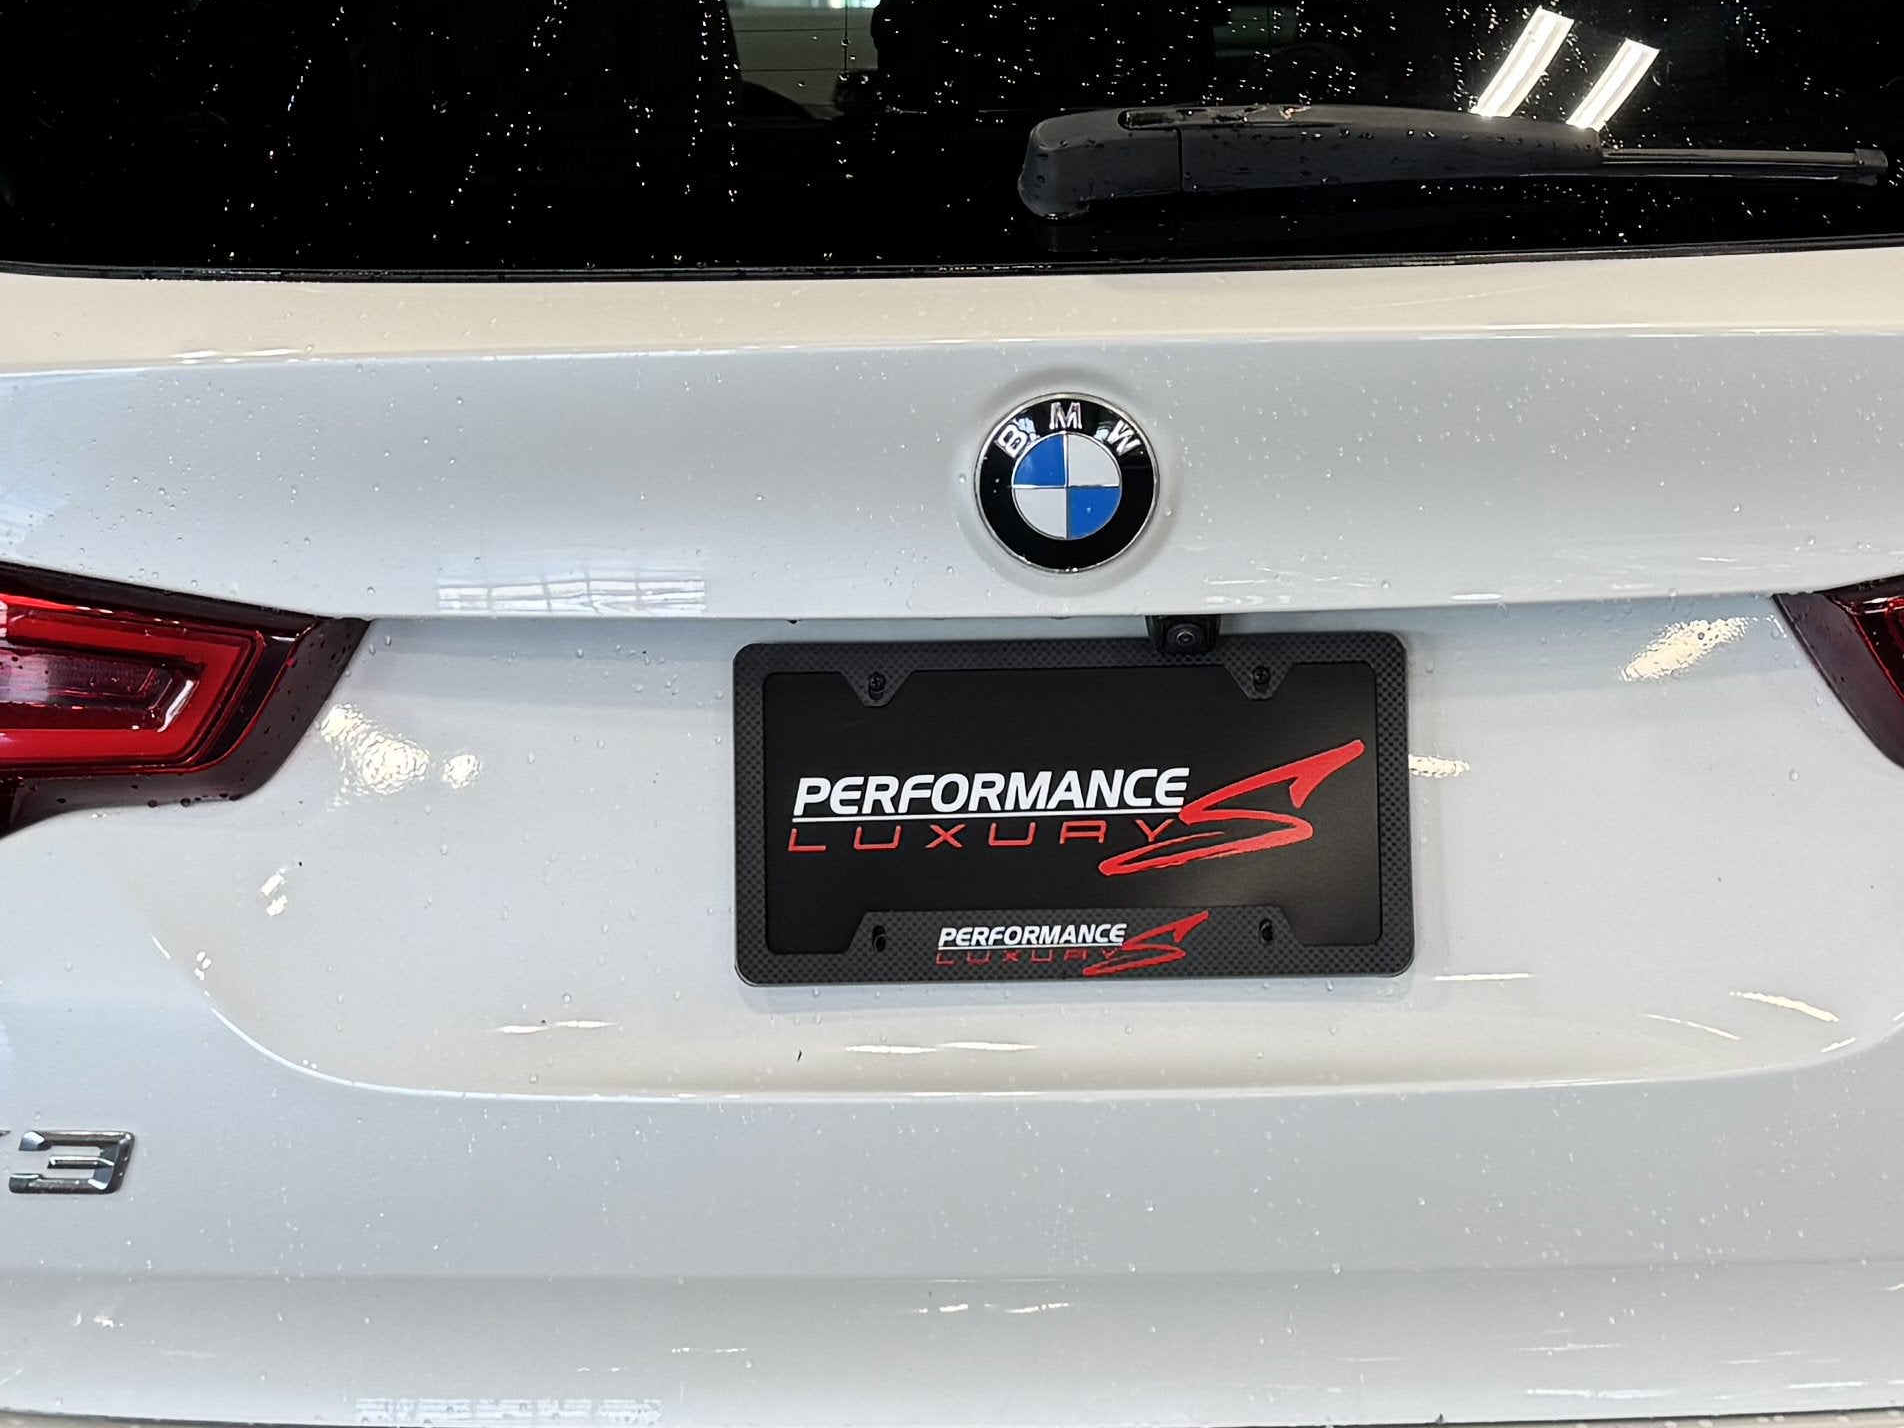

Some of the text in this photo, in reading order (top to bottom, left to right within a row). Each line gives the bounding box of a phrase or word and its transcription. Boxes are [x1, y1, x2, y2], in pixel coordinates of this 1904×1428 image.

[995, 401, 1142, 458] BMW
[793, 767, 1190, 816] PERFORMANCE
[788, 818, 1175, 852] LUXURY
[938, 923, 1127, 947] PERFORMANCE
[936, 949, 1118, 964] LUXURY
